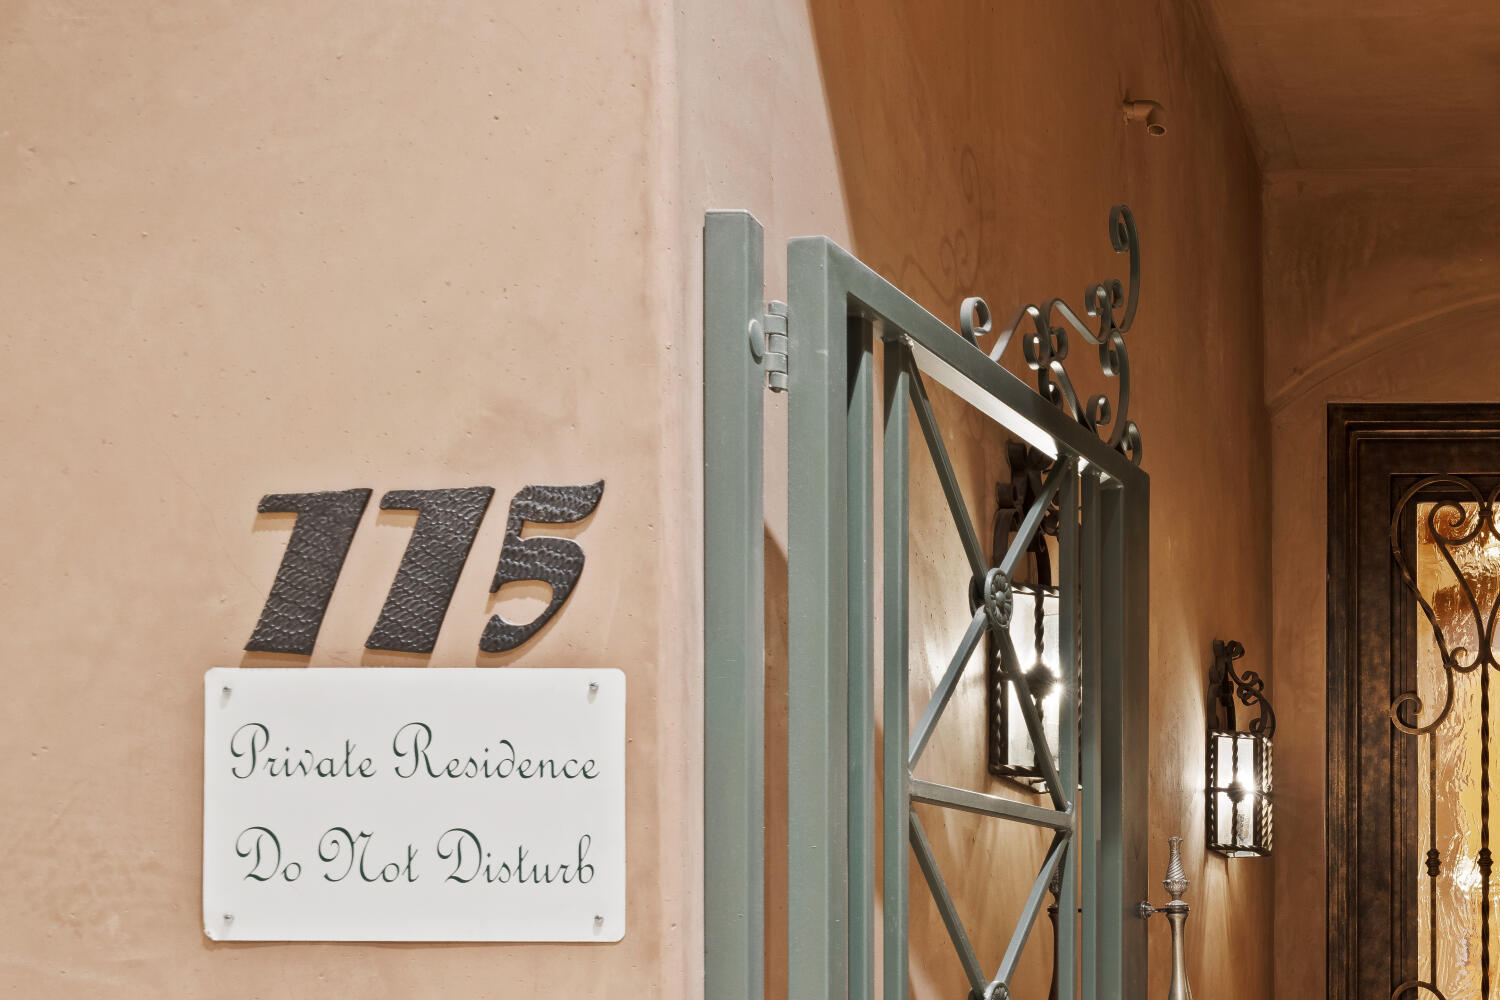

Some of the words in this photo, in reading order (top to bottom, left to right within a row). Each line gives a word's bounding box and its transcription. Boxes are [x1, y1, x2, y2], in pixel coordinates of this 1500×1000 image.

[230, 722, 377, 780] Private
[393, 721, 600, 780] Residence
[235, 825, 302, 882] Do
[318, 826, 419, 883] Not
[437, 827, 596, 885] Disturb
